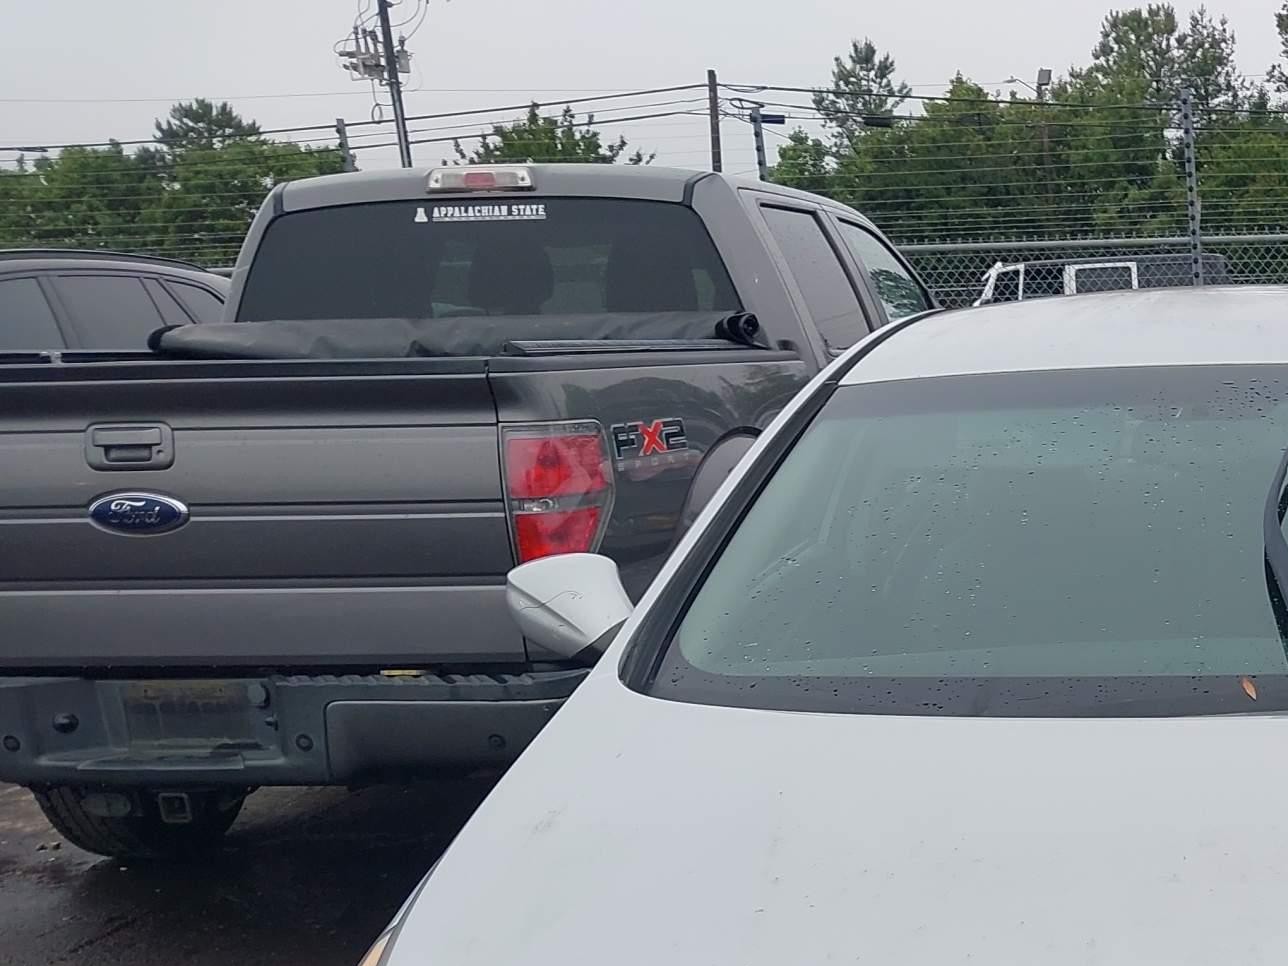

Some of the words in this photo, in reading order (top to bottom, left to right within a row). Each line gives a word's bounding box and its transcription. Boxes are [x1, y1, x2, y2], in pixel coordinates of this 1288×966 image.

[432, 205, 508, 218] APPALACHIAN
[511, 204, 546, 216] STATE
[610, 417, 689, 460] FX2
[108, 500, 161, 524] Ford
